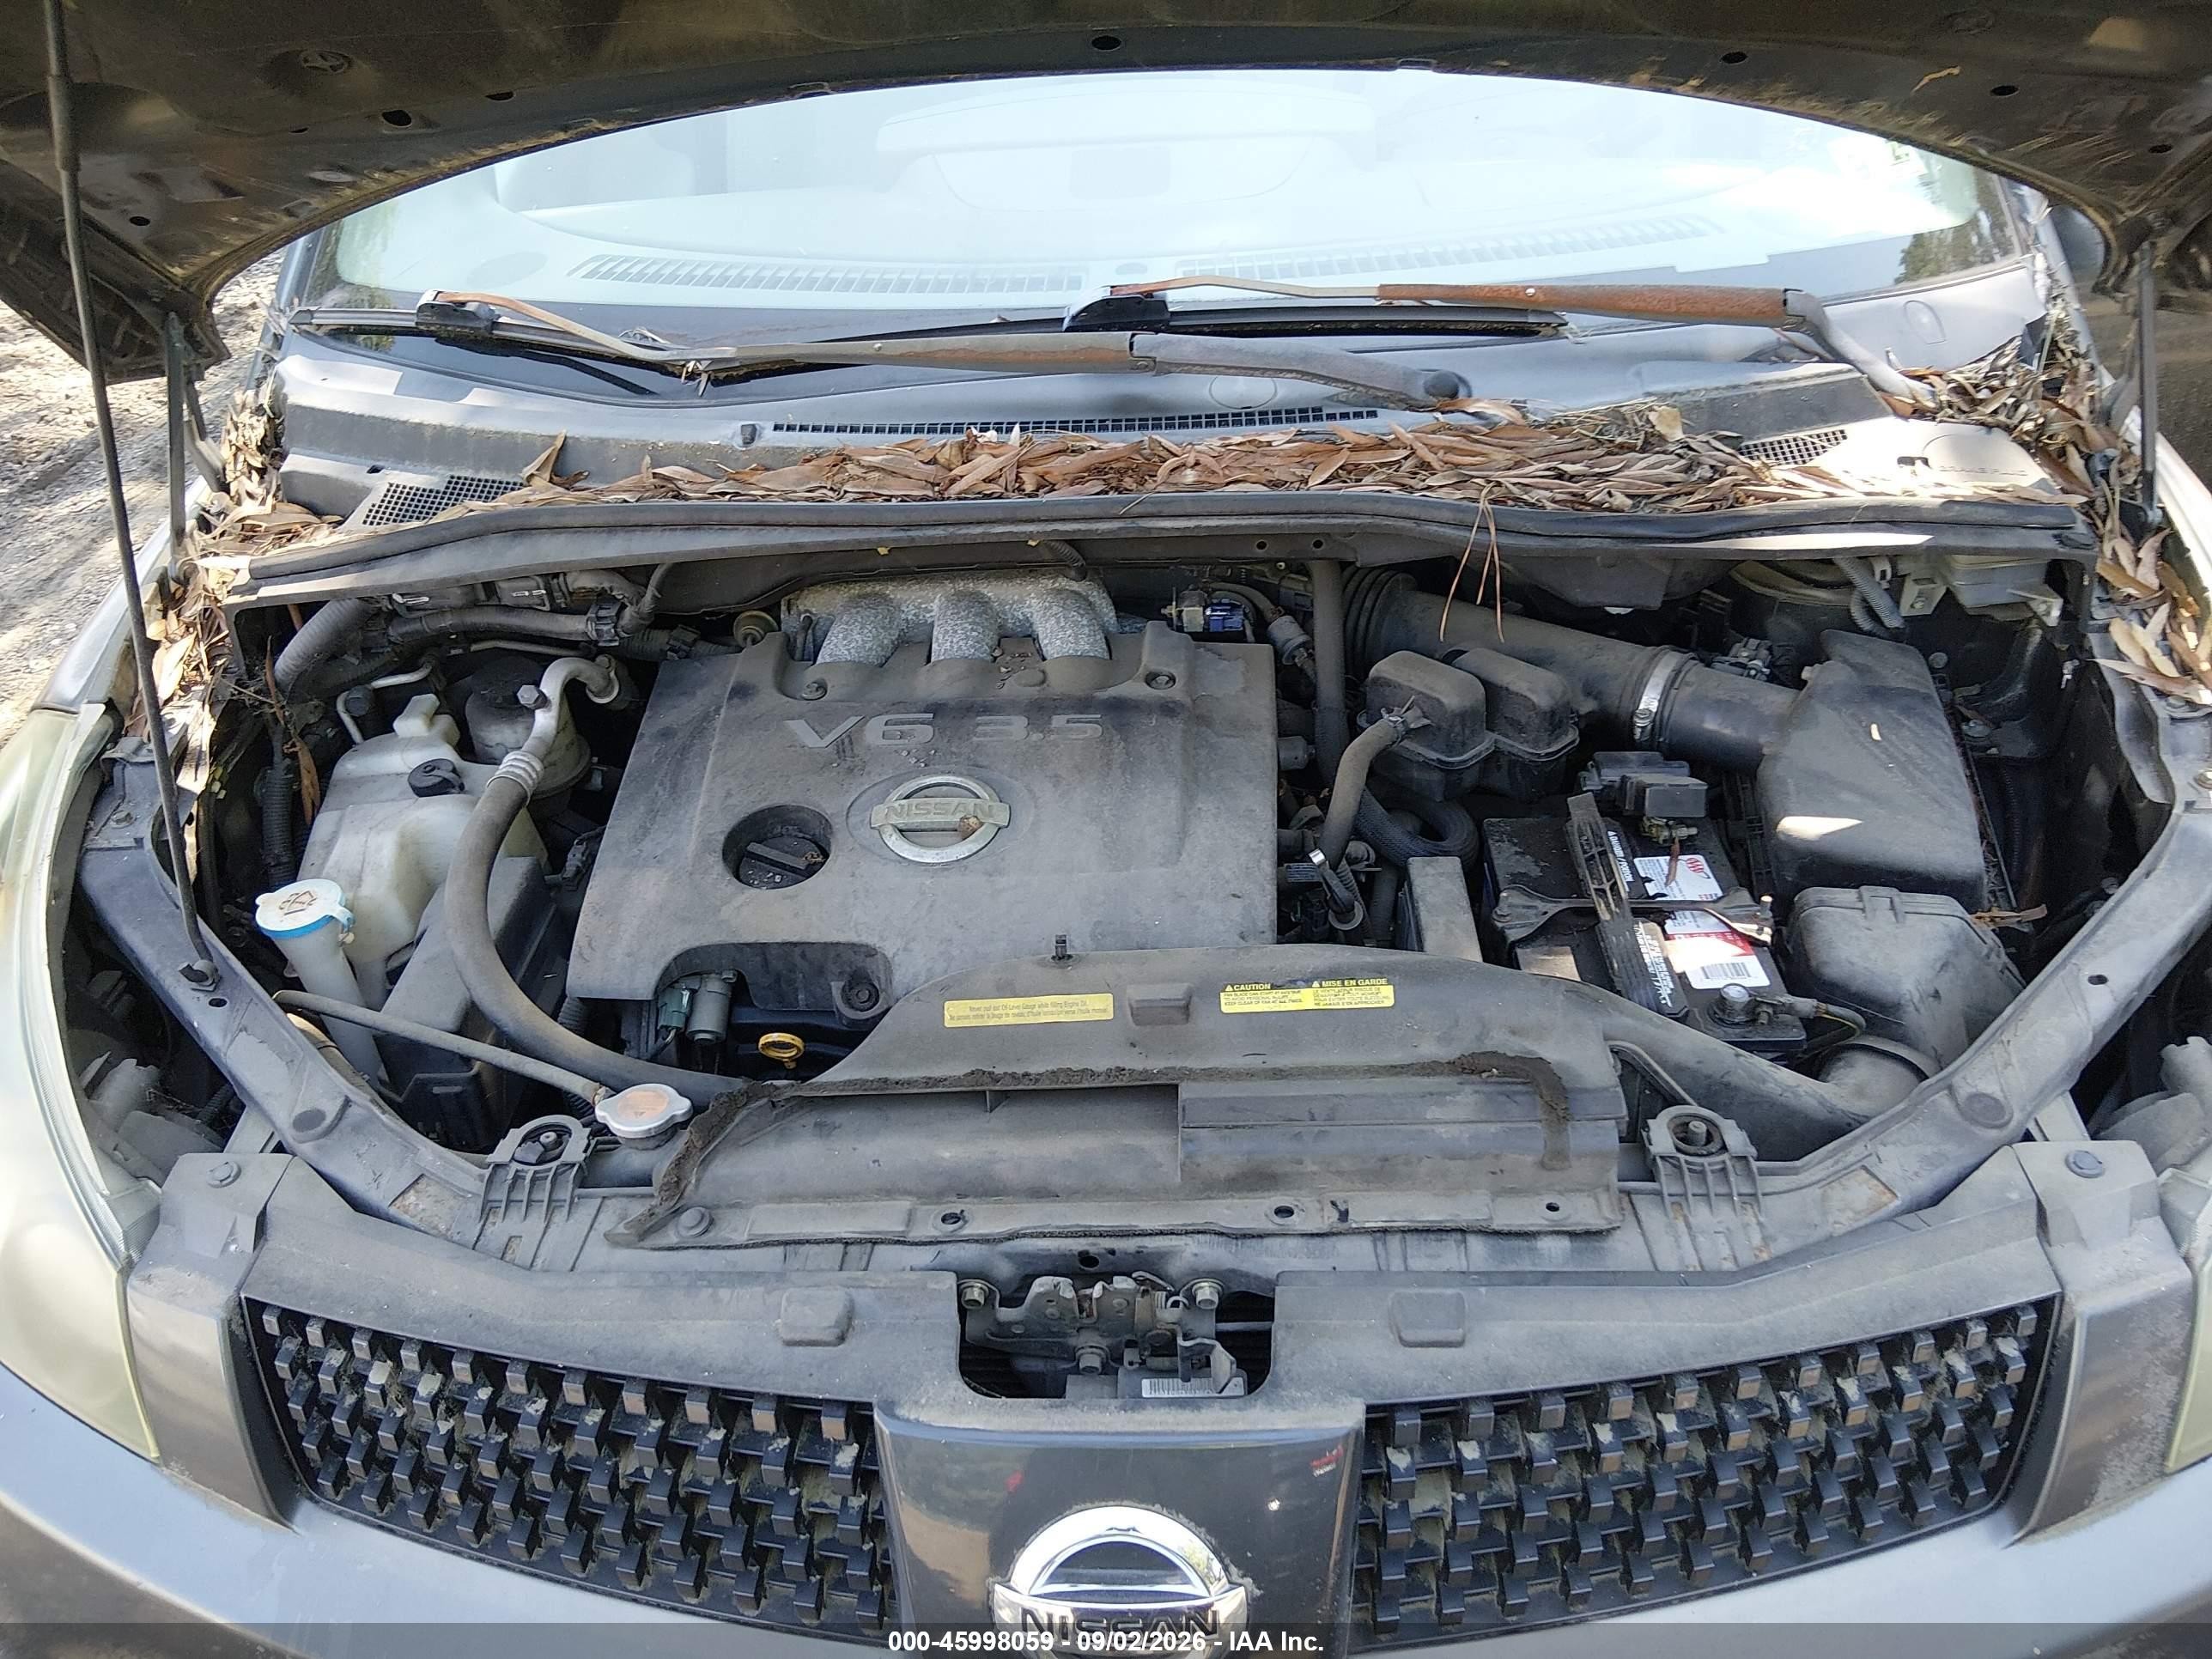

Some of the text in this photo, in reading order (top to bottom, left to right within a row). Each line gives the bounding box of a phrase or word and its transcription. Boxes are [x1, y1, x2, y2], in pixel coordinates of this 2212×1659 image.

[782, 713, 1103, 748] V6 3.5
[884, 802, 994, 818] NISSAN
[1021, 1607, 1220, 1649] NISSAN
